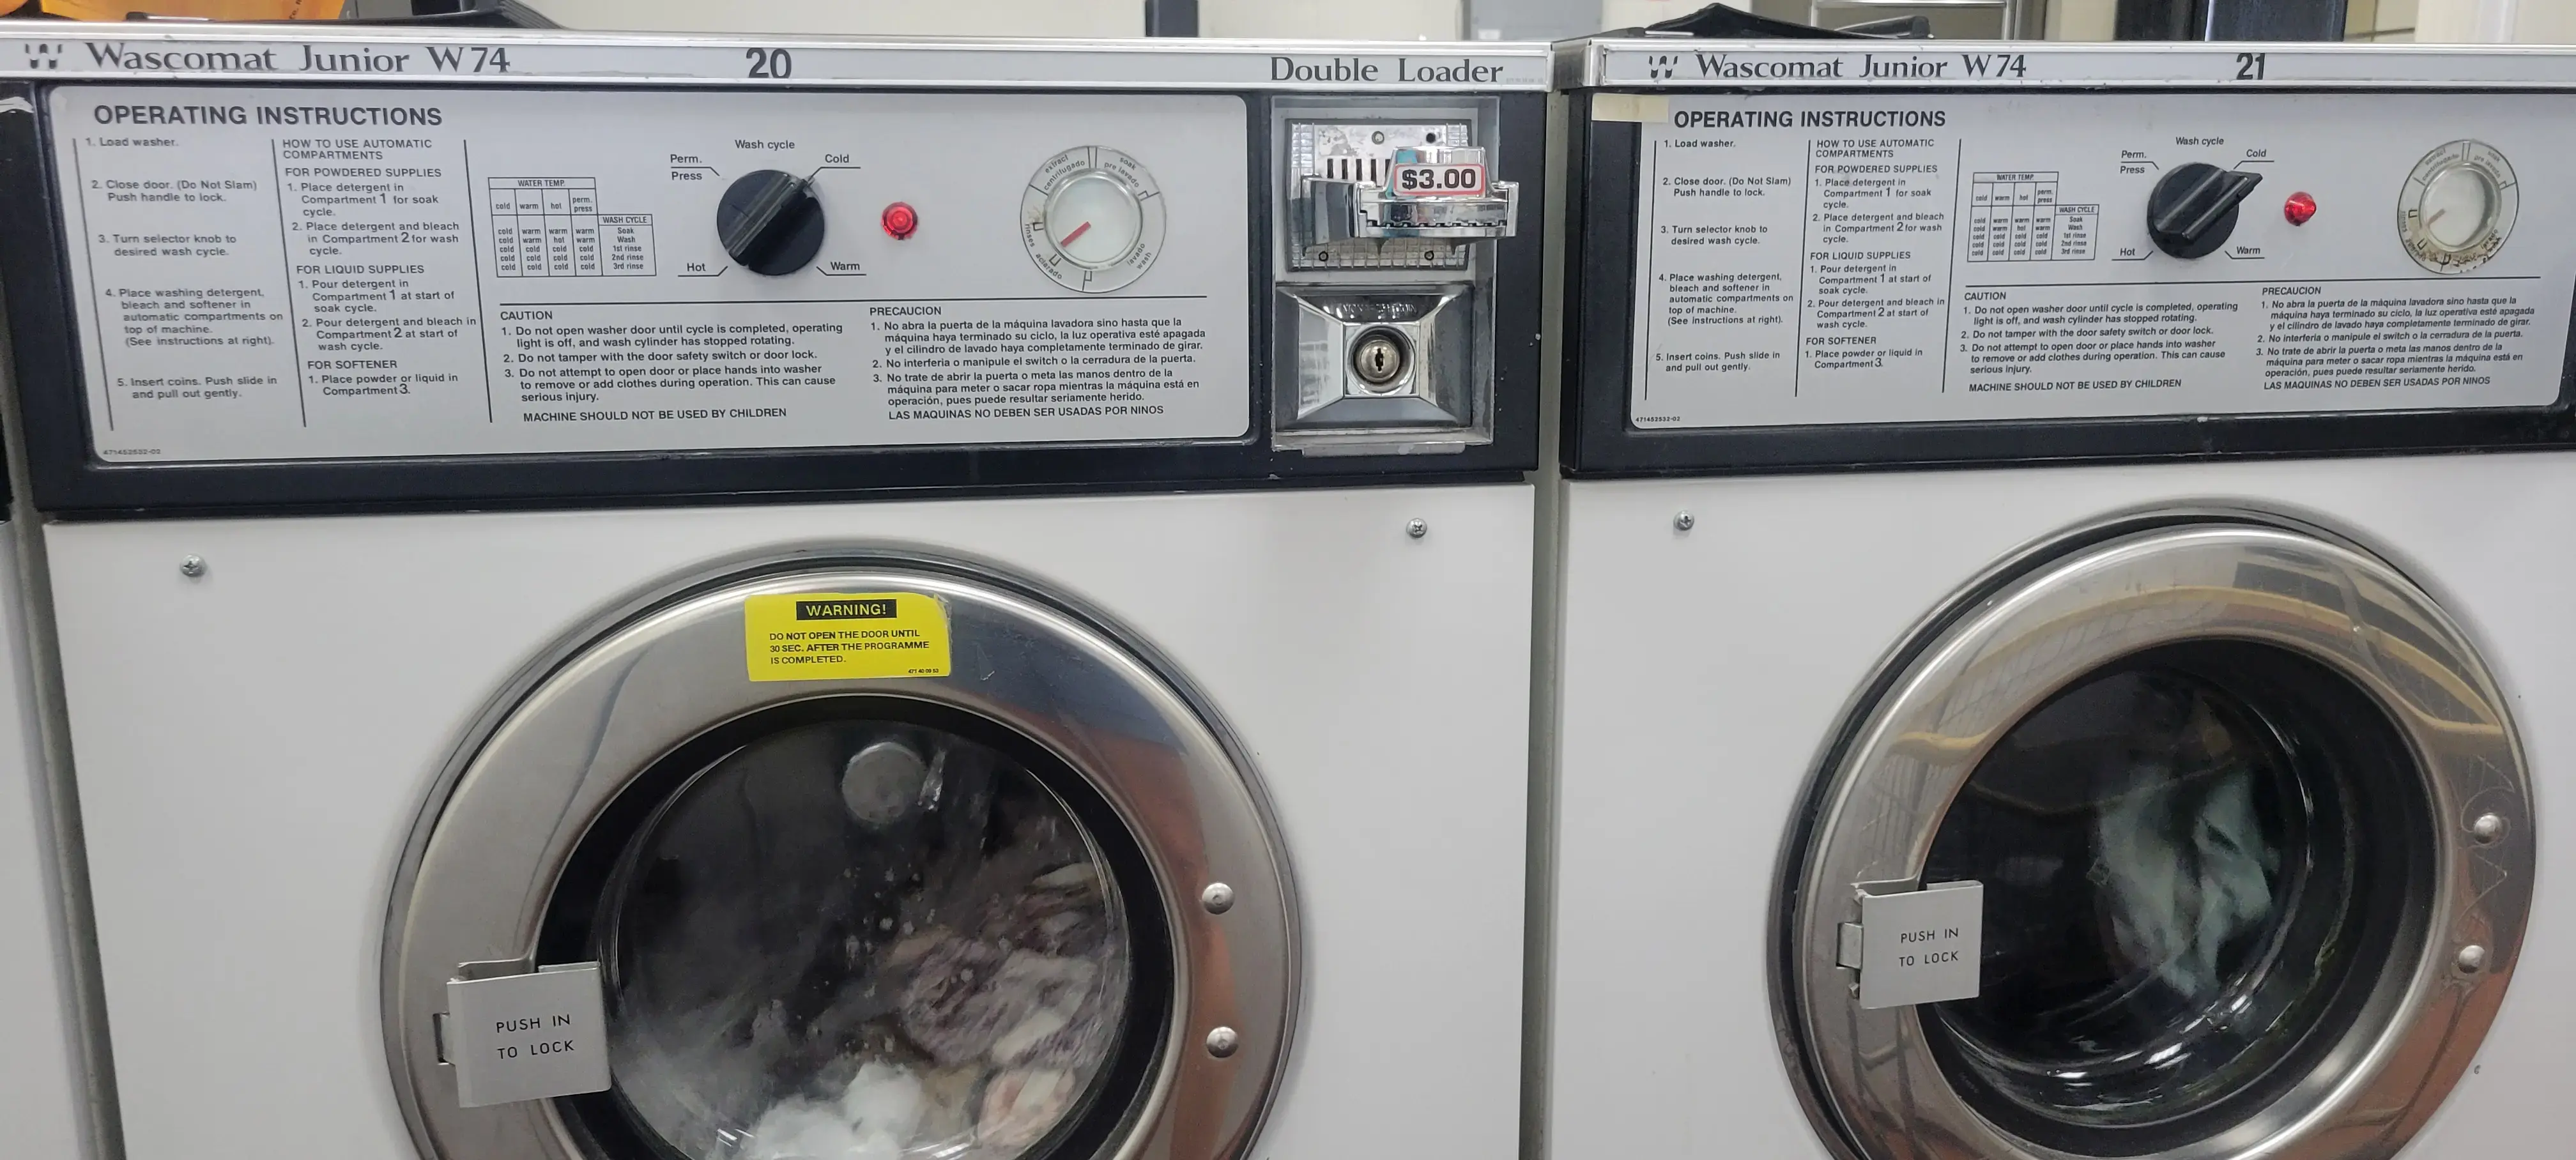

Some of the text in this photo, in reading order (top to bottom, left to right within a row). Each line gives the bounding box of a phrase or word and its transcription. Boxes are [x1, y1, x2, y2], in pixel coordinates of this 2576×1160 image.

[86, 44, 278, 71] Wascomat
[299, 46, 410, 72] Junior
[746, 48, 792, 78] 20
[1271, 55, 1503, 82] Double Loader
[1696, 54, 1843, 78] Wascomat
[1859, 54, 1947, 77] Junior
[2236, 52, 2266, 80] 21
[95, 105, 441, 125] OPERATING INSTRUCTIONS
[1675, 111, 1945, 128] OPERATING INSTRUCTIONS
[100, 137, 128, 146] Load
[283, 139, 432, 148] HOW TO USE AUTOMATIC
[735, 140, 795, 151] Wash cycle
[2176, 137, 2224, 147] Wash cycle
[284, 151, 383, 160] COMPARTMENTS
[825, 154, 850, 163] Cold
[2121, 150, 2147, 159] Perm.
[2246, 149, 2267, 158] Cold
[670, 154, 702, 164] Perm.
[1119, 157, 1137, 171] soak
[286, 168, 441, 177] FOR POWDERED SUPPLIES
[2120, 165, 2145, 174] Press
[671, 172, 702, 180] Press
[1104, 162, 1139, 188] pre lavado
[1402, 169, 1476, 190] $3.00
[91, 180, 256, 190] 2. Close door. (Do Not Slam)
[107, 193, 137, 201] Push
[141, 193, 180, 201] handle
[199, 193, 226, 201] lock.
[1024, 224, 1035, 247] rinses
[1127, 243, 1145, 265] lavado
[2120, 247, 2135, 256] Hot
[2236, 247, 2260, 255] Warm
[831, 262, 860, 270] Warm
[1137, 252, 1151, 270] wash
[296, 265, 424, 274] FOR LIQUID SUPPLIES
[687, 263, 706, 272] Hot
[1036, 253, 1062, 280] aclarado
[1965, 292, 2006, 300] CAUTION
[2262, 287, 2321, 295] PRECAUCION
[500, 311, 552, 320] CAUTION
[870, 307, 941, 316] PRECAUCION
[871, 317, 1181, 332] 1. No abra la puerta de la máquina lavadora sino hasta que la
[502, 323, 842, 339] 1. Do not open washer door until cycle is completed, operating
[308, 360, 397, 369] FOR SOFTENER
[1969, 383, 2011, 392] MACHINE
[2014, 383, 2053, 391] SHOULD
[2135, 379, 2181, 388] CHILDREN
[524, 408, 786, 422] MACHINE SHOULD NOT BE USED BY CHILDREN
[889, 406, 1163, 420] LAS MAQUINAS NO DEBEN SER USADAS POR NINOS
[806, 604, 887, 616] WARNING!
[864, 641, 929, 650] PROGRAMME
[782, 655, 846, 664] COMPLETED.
[1901, 927, 1958, 943] PUSH IN
[1899, 951, 1958, 966] TO LOCK
[496, 1014, 570, 1033] PUSH IN
[497, 1040, 574, 1059] TO LOCK
